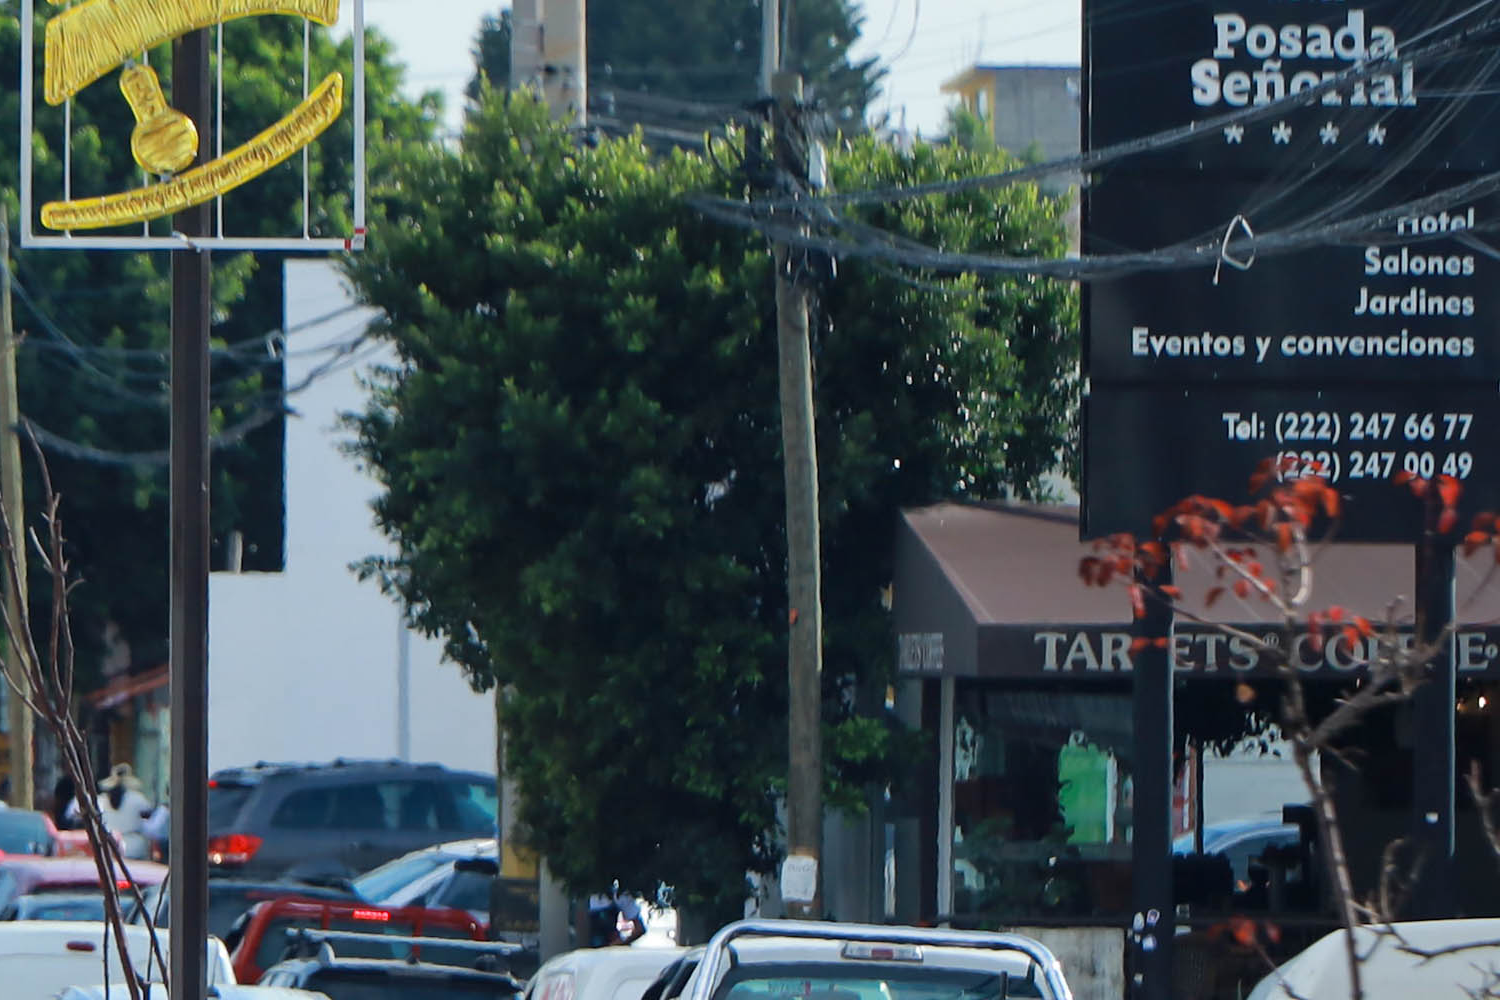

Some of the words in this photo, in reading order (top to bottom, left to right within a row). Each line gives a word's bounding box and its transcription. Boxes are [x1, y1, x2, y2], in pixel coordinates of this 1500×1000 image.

[1212, 9, 1398, 60] Posada
[1190, 59, 1417, 107] Señorial
[1364, 246, 1475, 276] Salones
[1354, 286, 1475, 316] Jardines
[1132, 327, 1246, 357] Eventos
[1256, 336, 1271, 362] y
[1281, 326, 1475, 357] convenciones
[1222, 412, 1265, 441] Tel:
[1275, 412, 1341, 444] (222)
[1349, 413, 1395, 440] 247
[1403, 412, 1435, 441] 66
[1443, 413, 1474, 440] 77
[1275, 451, 1341, 483] (222)
[1349, 452, 1396, 479] 247
[1403, 451, 1435, 480] 00
[1442, 451, 1474, 480] 49
[1034, 631, 1260, 672] TARETS
